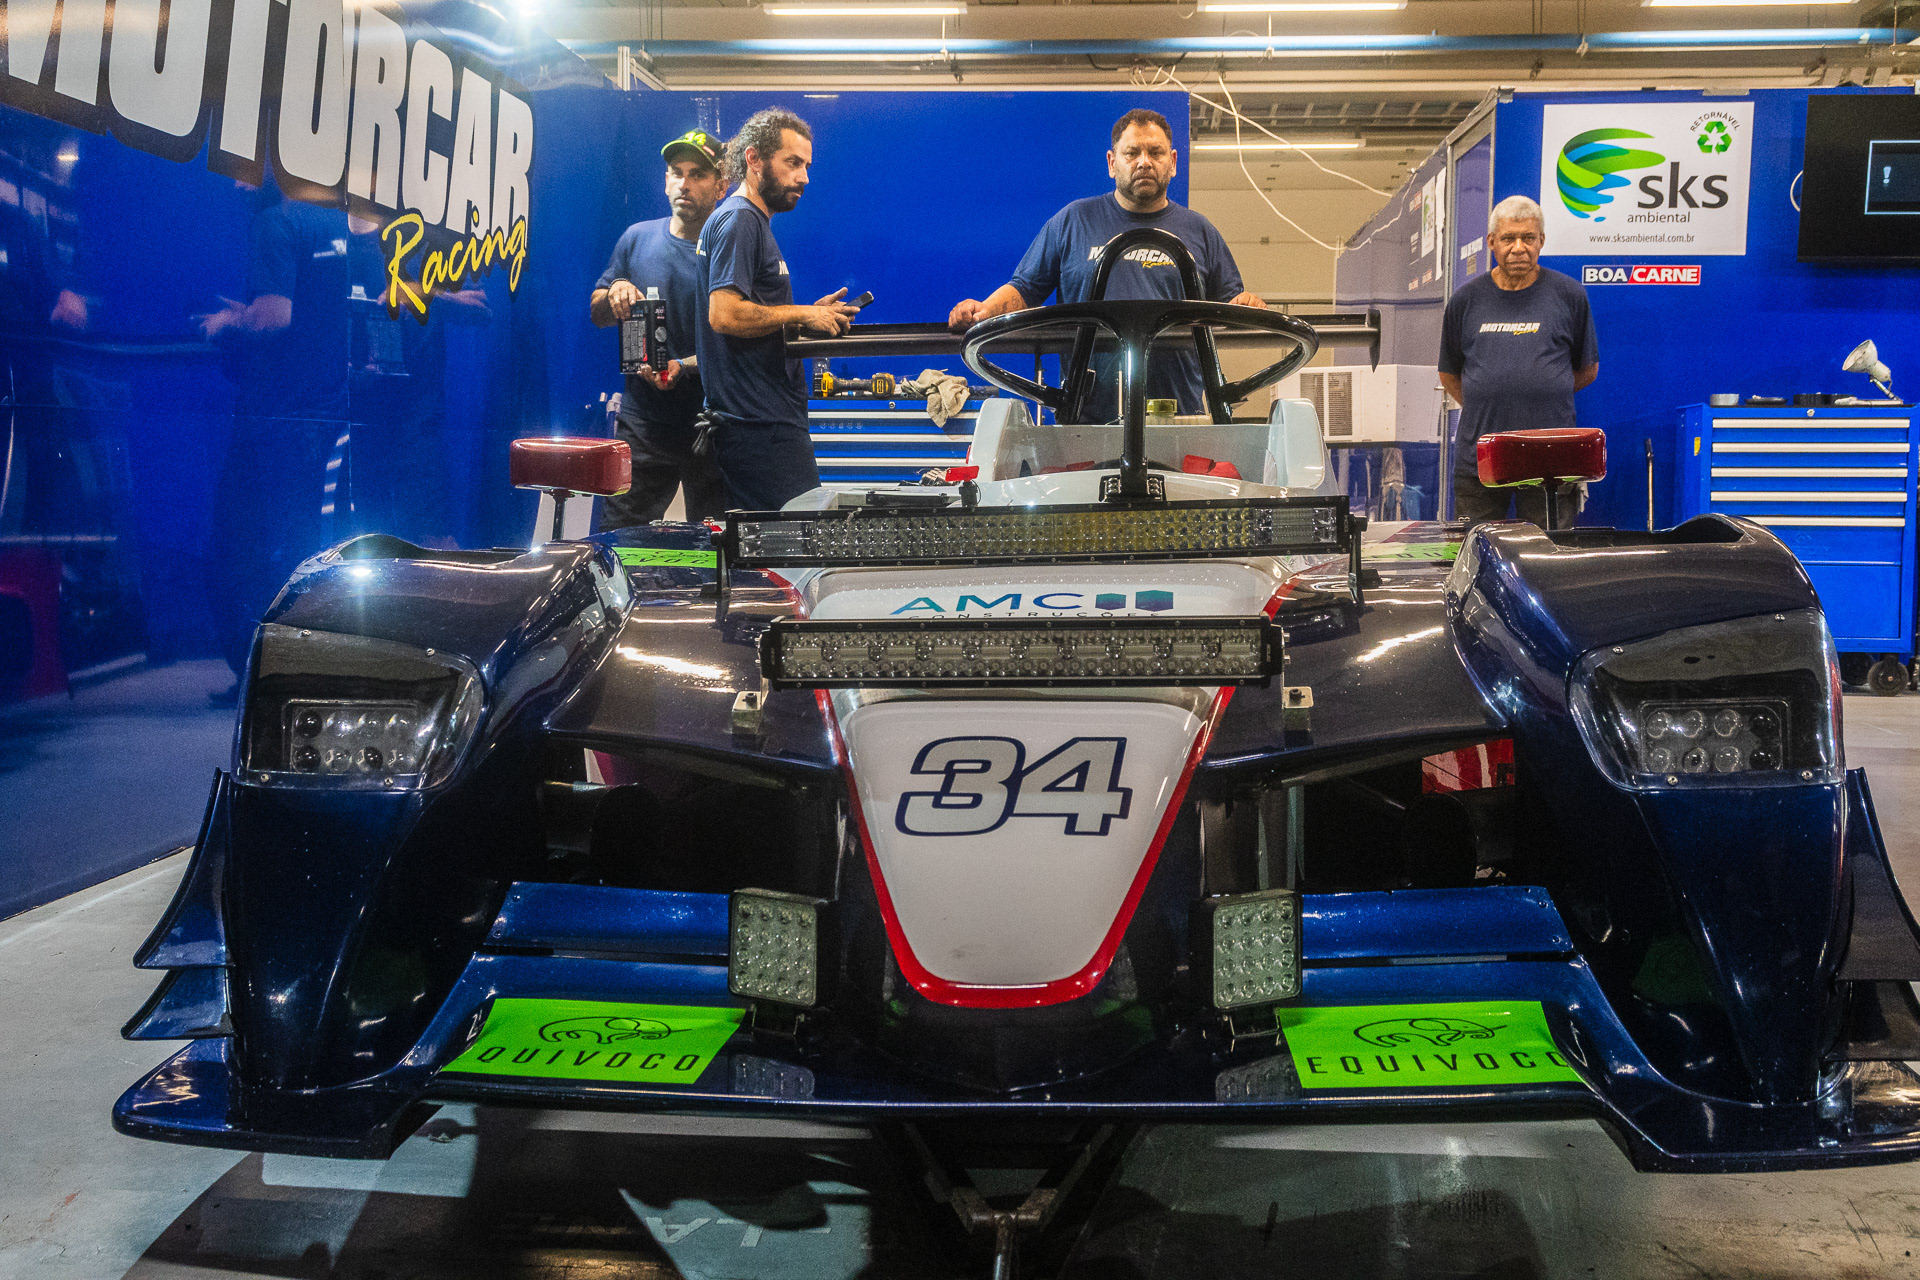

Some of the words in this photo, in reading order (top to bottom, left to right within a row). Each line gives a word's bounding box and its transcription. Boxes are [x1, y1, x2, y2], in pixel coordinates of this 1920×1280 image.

[1690, 111, 1740, 132] RETORNÁVEL
[1637, 161, 1729, 209] sks
[1627, 211, 1691, 223] ambiental
[1589, 233, 1695, 243] www.sksambiental.com.br
[382, 213, 526, 314] Racing
[1585, 267, 1628, 282] BOA
[1632, 267, 1699, 282] CARNE
[1479, 322, 1540, 333] MOTORCAR
[889, 592, 1084, 615] AMC
[895, 735, 1133, 836] 34
[476, 1046, 700, 1071] QUIVOCO
